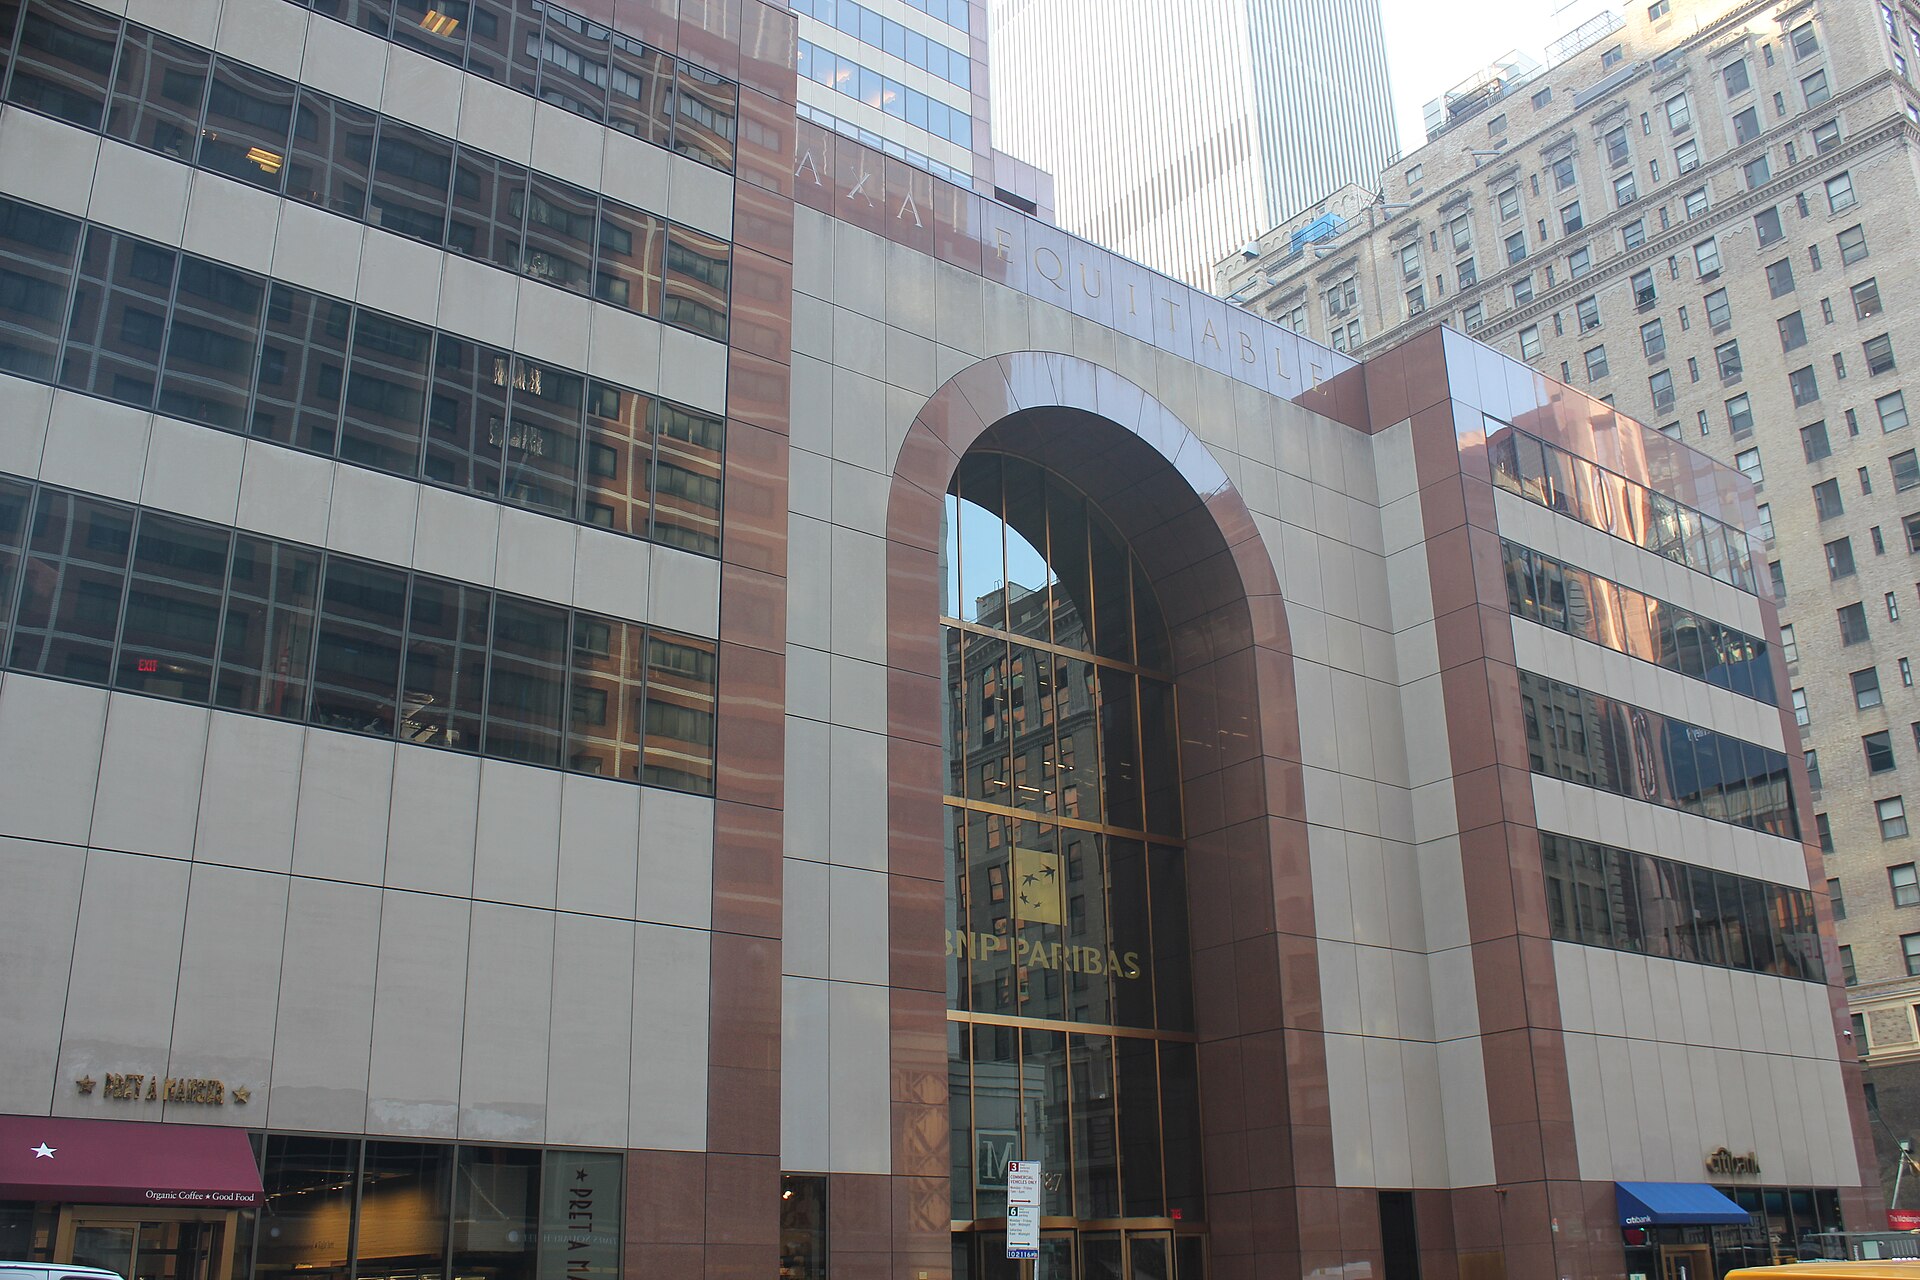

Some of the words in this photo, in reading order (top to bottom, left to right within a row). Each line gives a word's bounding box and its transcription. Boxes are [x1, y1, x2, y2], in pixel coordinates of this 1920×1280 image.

[794, 148, 923, 229] AXA
[995, 226, 1328, 396] EQUITABLE
[138, 659, 158, 672] EXIT
[1010, 936, 1141, 979] PARIBAS
[1011, 1162, 1017, 1171] 3
[1039, 1171, 1063, 1192] 87
[145, 1190, 177, 1200] Organic
[178, 1191, 203, 1200] Coffee
[212, 1192, 234, 1201] Good
[235, 1193, 254, 1201] Food
[568, 1188, 593, 1232] PRET
[1010, 1207, 1017, 1216] 6
[1625, 1215, 1652, 1224] citibank
[567, 1240, 590, 1251] A
